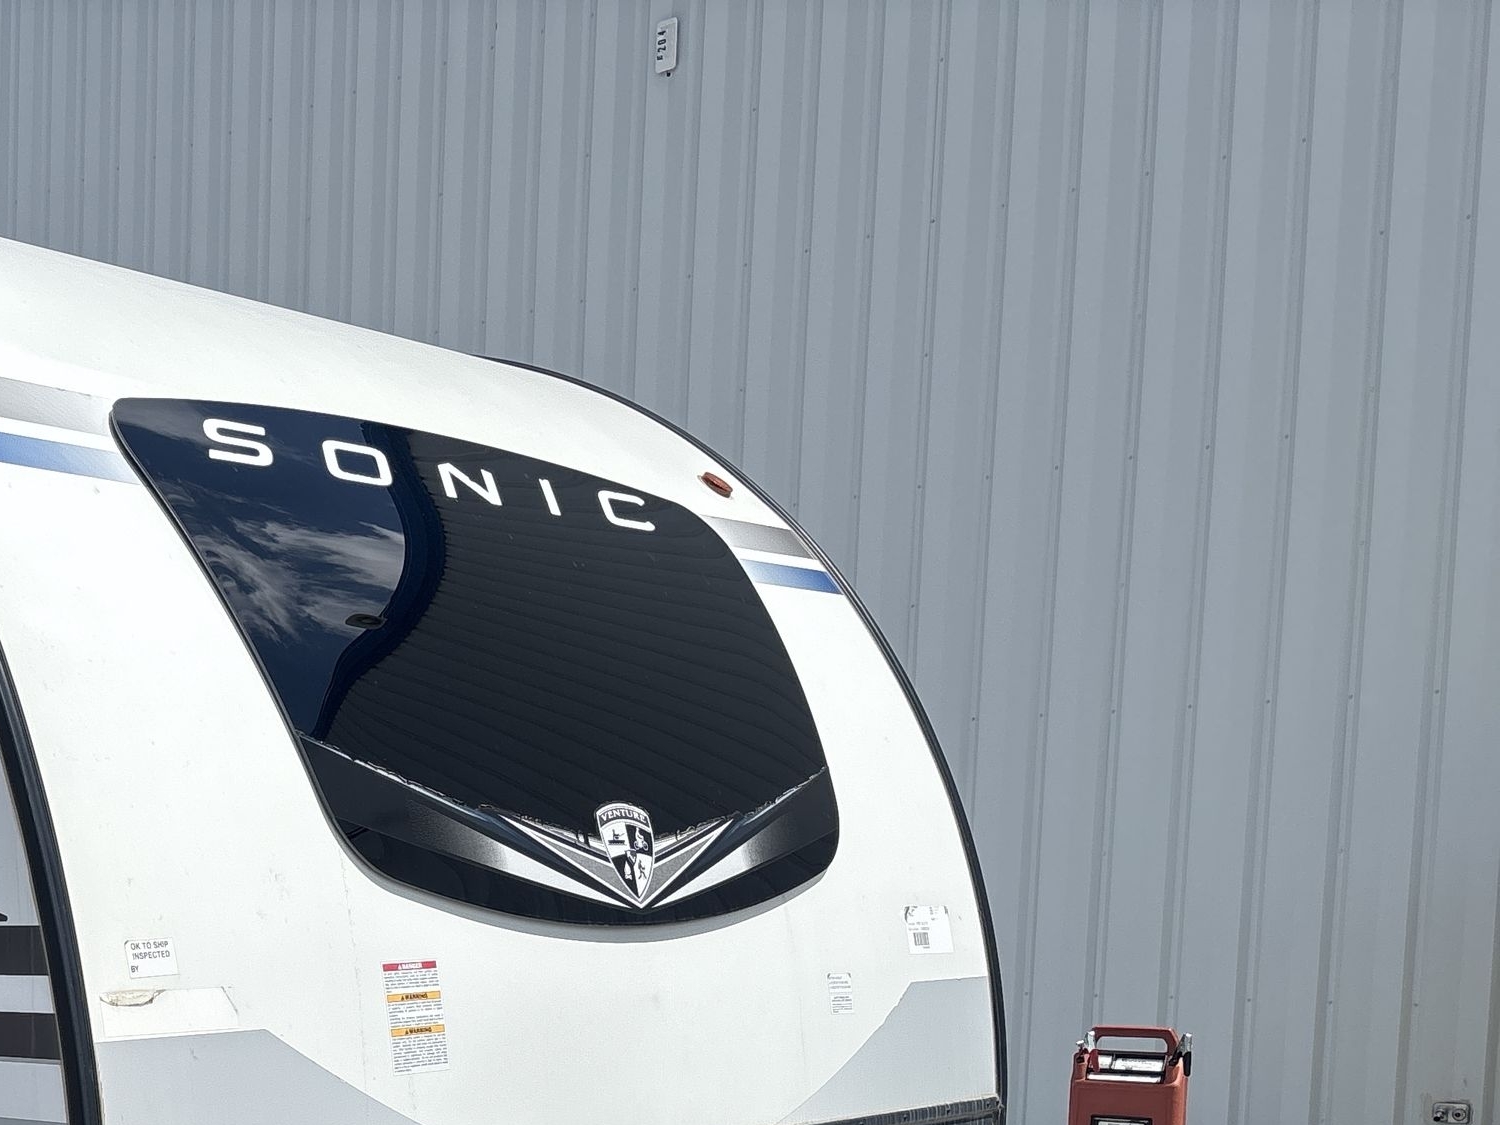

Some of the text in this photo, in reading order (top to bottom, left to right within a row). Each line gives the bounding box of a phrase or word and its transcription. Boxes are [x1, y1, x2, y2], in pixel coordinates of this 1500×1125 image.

[202, 417, 656, 533] SONIC
[601, 809, 647, 824] VENTURE
[130, 943, 141, 951] OK
[153, 940, 169, 949] SHIP
[132, 950, 171, 960] INSPECTED
